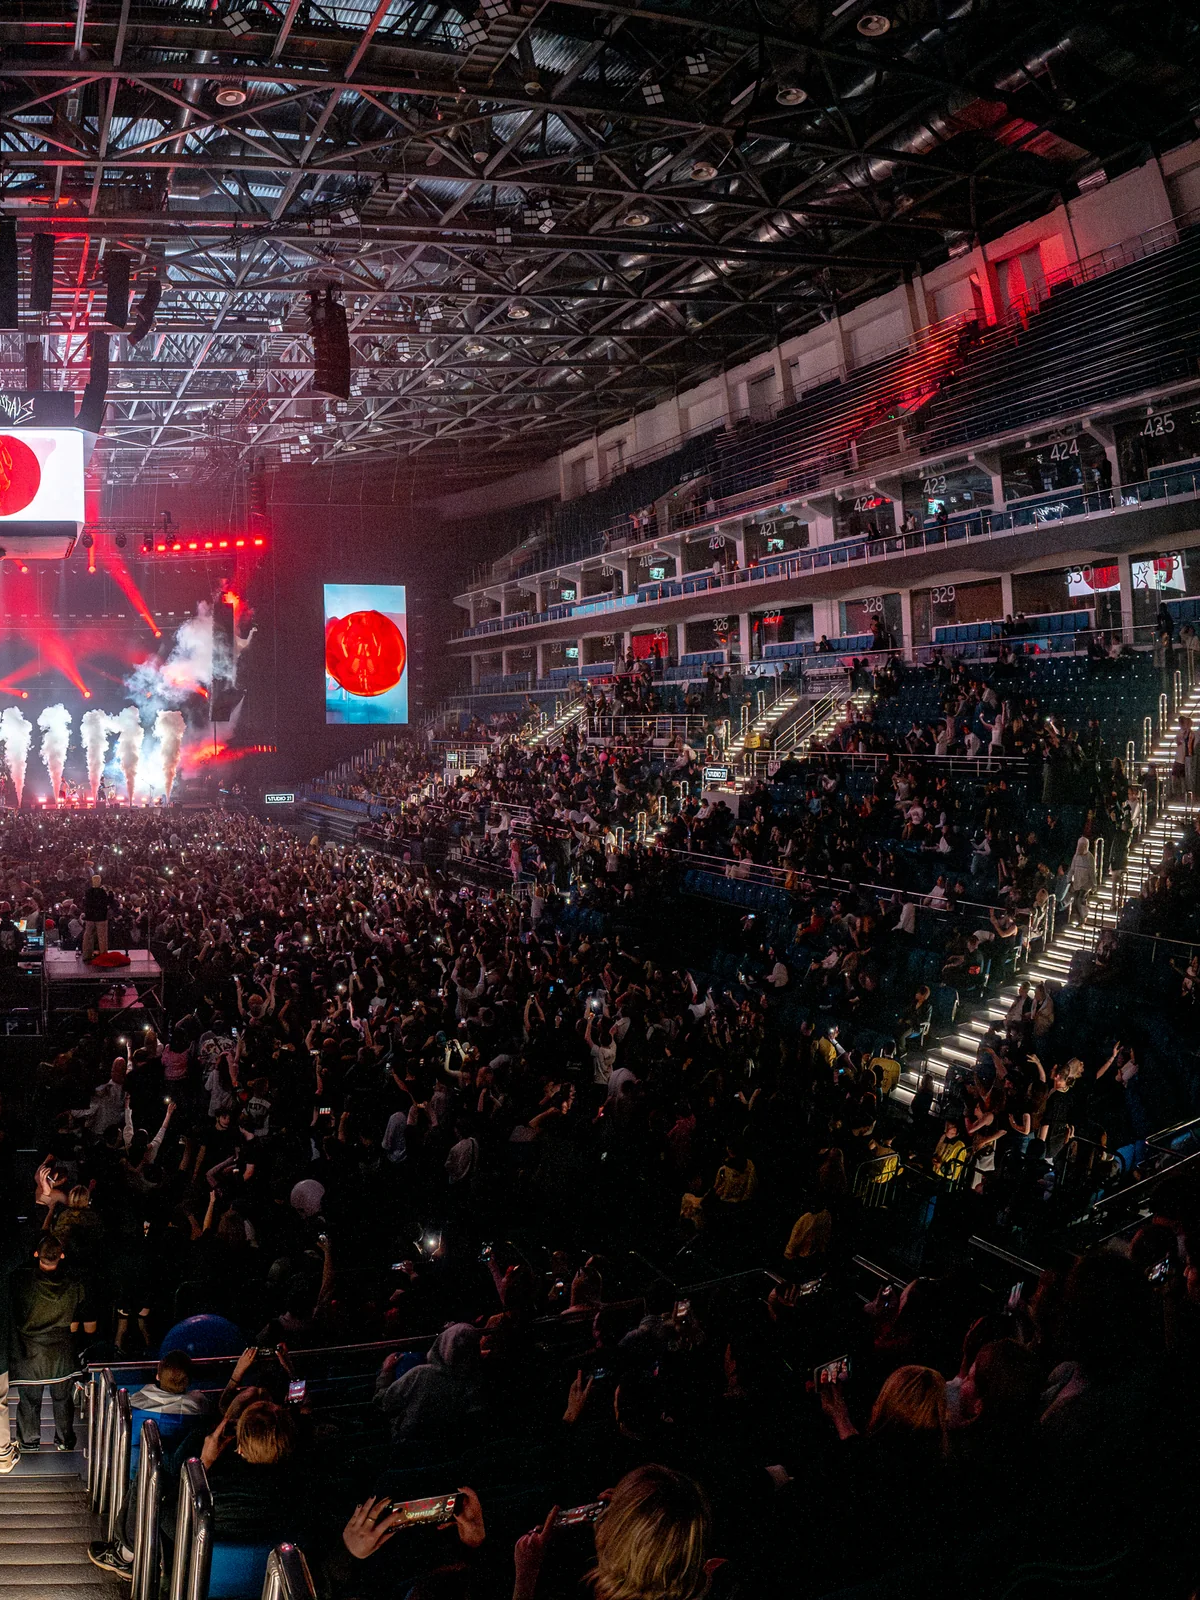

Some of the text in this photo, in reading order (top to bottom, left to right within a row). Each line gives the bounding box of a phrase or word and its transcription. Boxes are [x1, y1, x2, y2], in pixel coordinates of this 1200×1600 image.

[1144, 413, 1175, 438] 425
[1050, 439, 1079, 461] 424
[923, 475, 947, 495] 423
[854, 495, 875, 512] 422
[760, 523, 777, 536] 421
[709, 535, 725, 550] 420
[1159, 550, 1190, 571] 331
[601, 565, 614, 577] 418
[1064, 564, 1093, 586] 330
[932, 586, 956, 604] 329
[862, 597, 883, 614] 328
[712, 618, 728, 632] 326
[763, 610, 781, 625] 327
[603, 635, 615, 647] 324
[653, 628, 668, 640] 325
